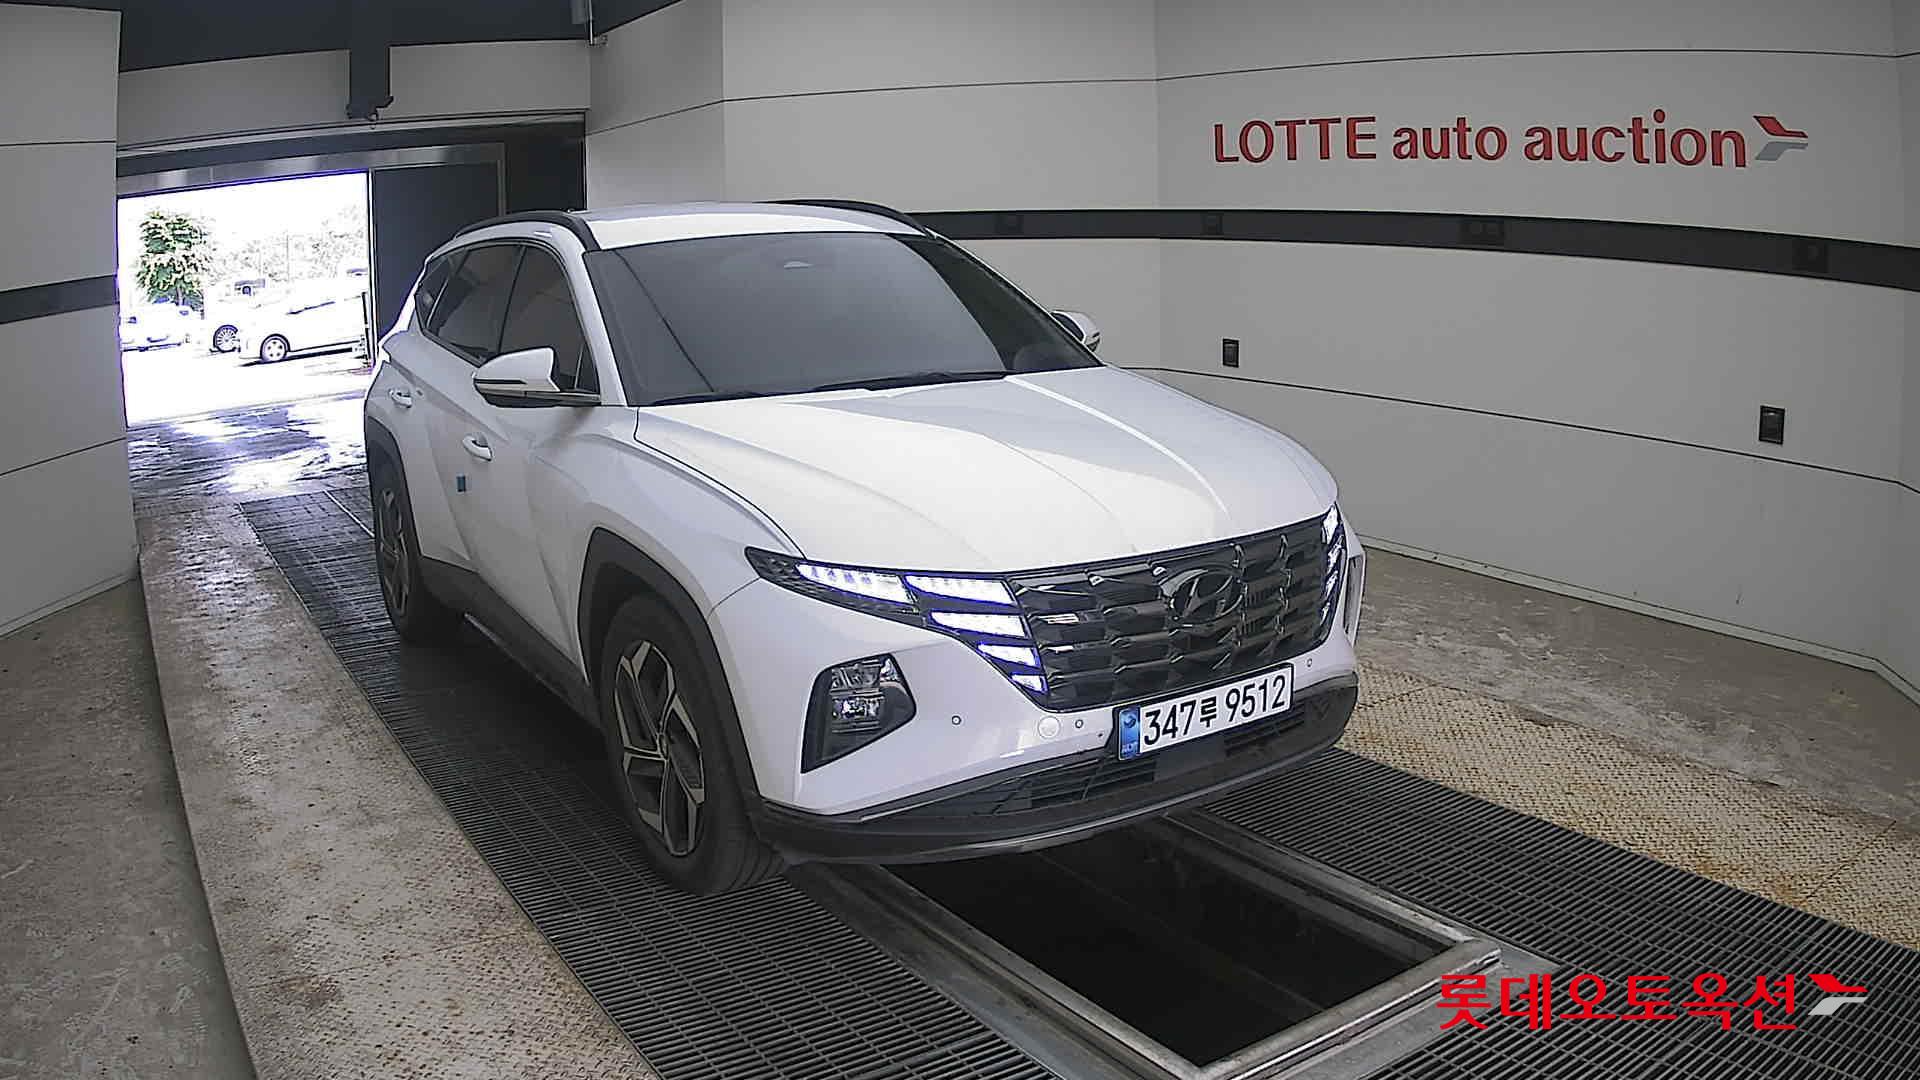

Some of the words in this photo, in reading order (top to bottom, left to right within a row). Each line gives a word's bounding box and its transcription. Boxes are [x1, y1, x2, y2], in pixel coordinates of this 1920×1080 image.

[1214, 117, 1377, 162] LOTTE
[1392, 117, 1507, 160] auto
[1523, 109, 1746, 168] auction
[1144, 696, 1217, 745] 347루
[1225, 675, 1286, 722] 9512
